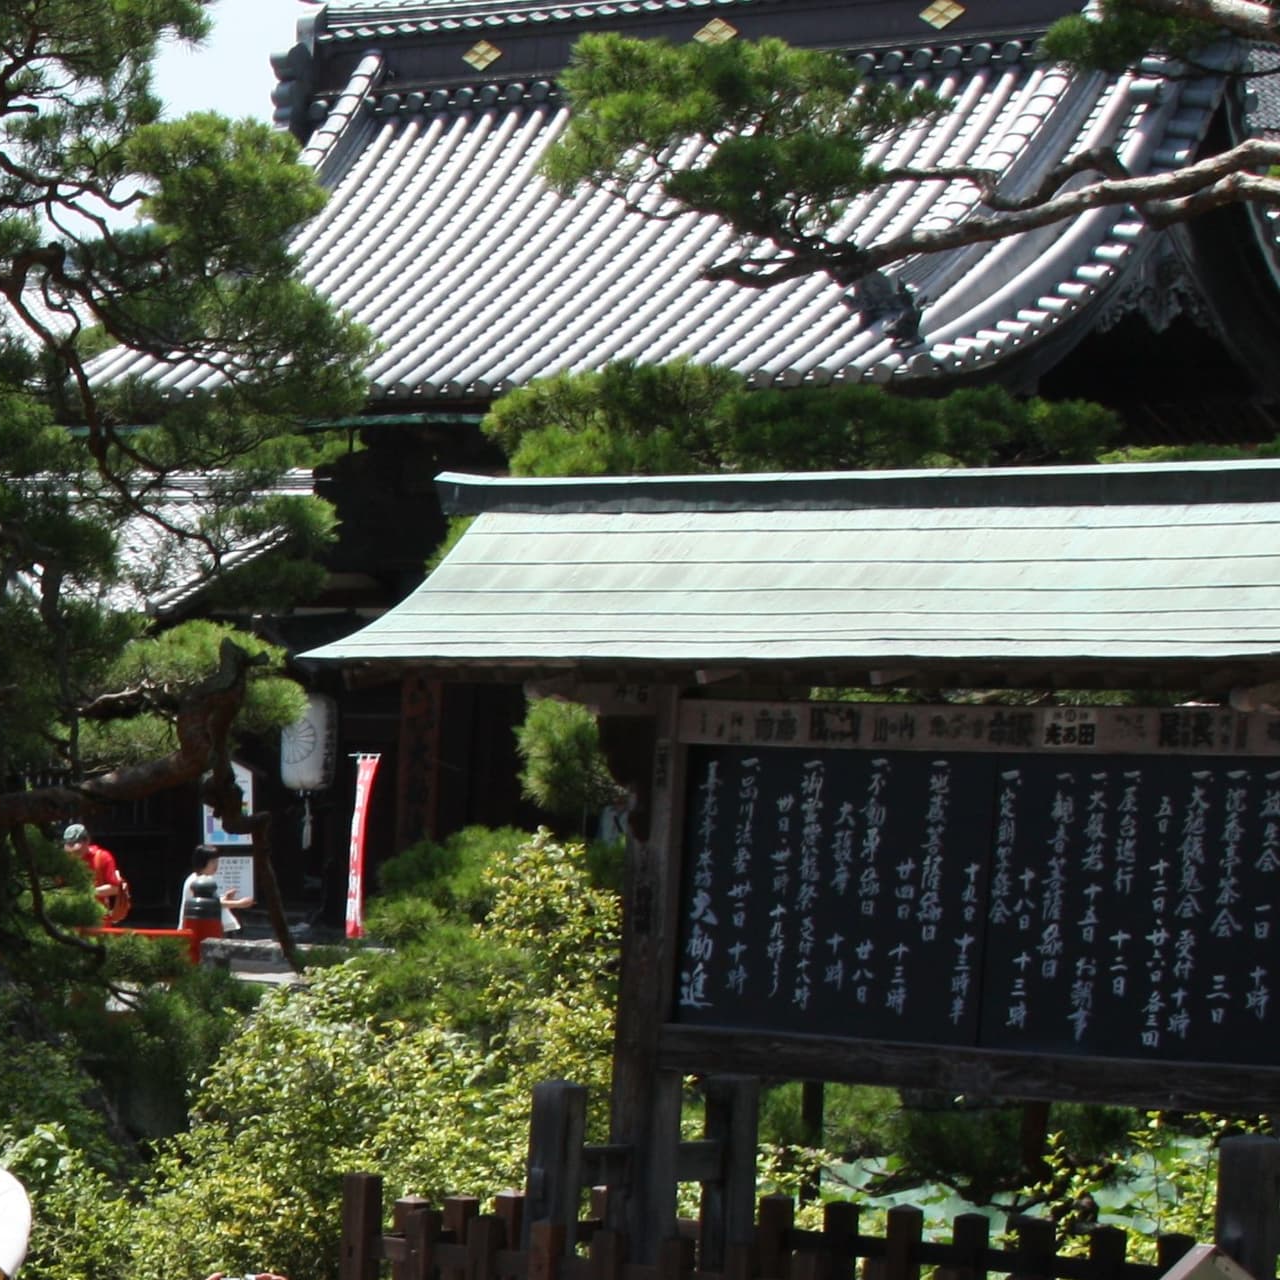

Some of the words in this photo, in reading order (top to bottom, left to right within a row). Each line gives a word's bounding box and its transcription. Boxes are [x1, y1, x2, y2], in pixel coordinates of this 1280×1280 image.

[1012, 866, 1037, 932] 十八日
[1108, 929, 1133, 998] 十二日
